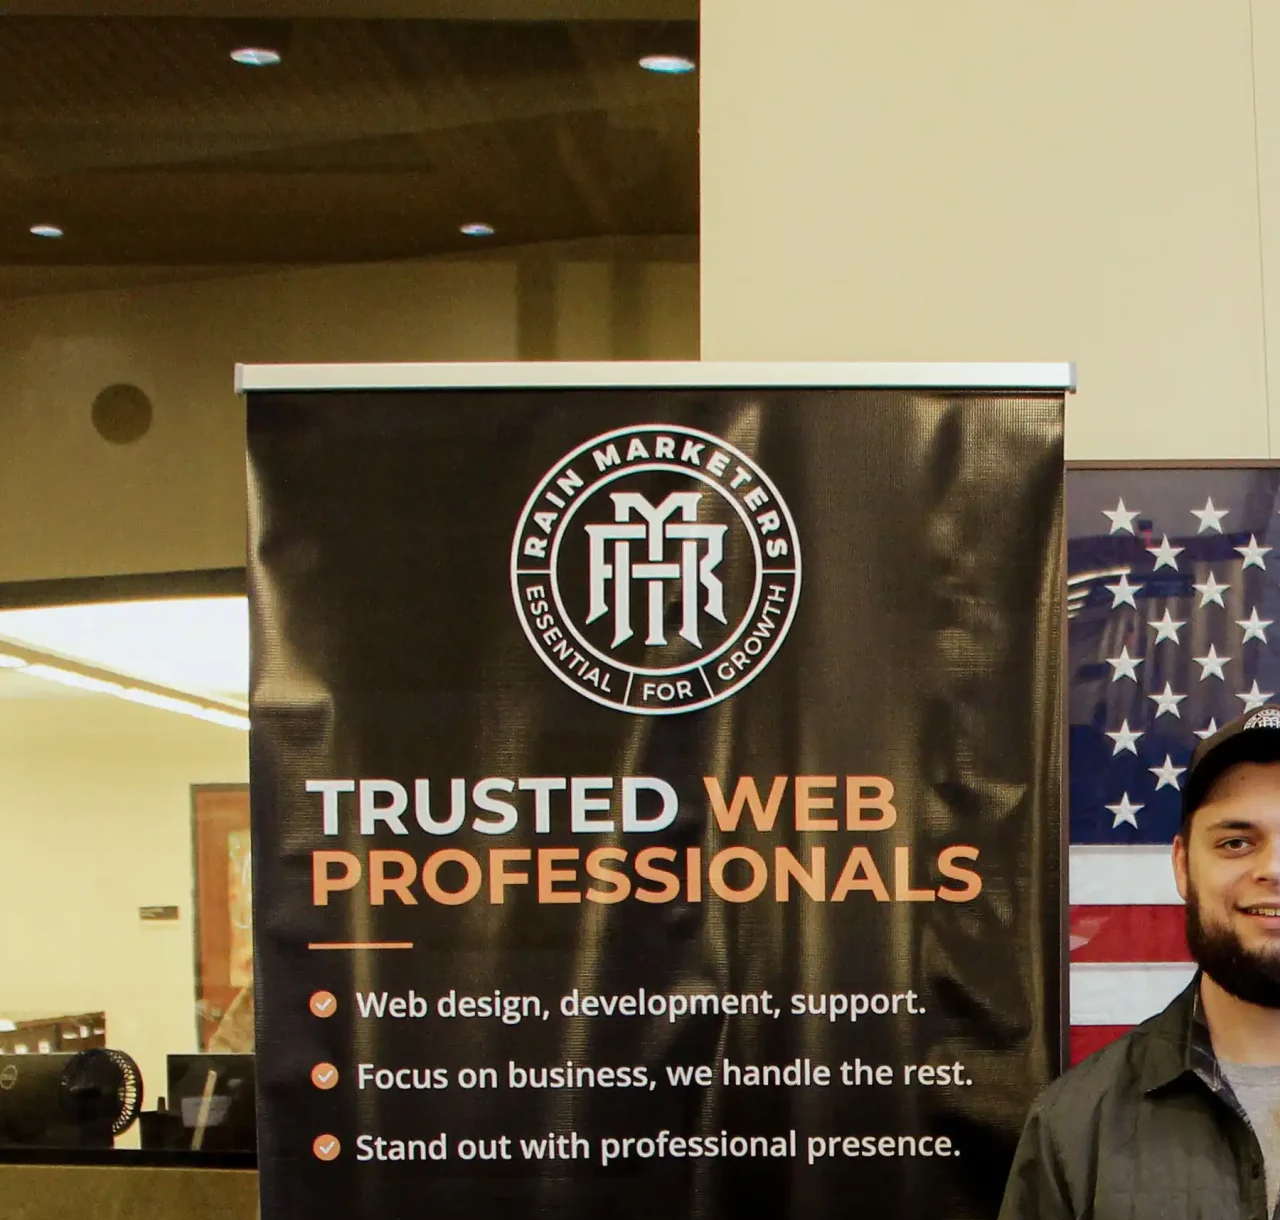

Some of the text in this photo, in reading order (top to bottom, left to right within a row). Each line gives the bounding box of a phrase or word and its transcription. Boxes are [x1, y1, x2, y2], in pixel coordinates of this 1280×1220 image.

[524, 436, 788, 559] RAIN MARKETERS
[525, 584, 787, 701] ESSENTIAL FOR GROWTH
[306, 777, 896, 833] TRUSTED WEB
[313, 847, 982, 904] PROFESSIONALS
[356, 988, 925, 1023] Web design, development, support.
[358, 1058, 972, 1089] Focus on business, we handle the rest.
[356, 1131, 960, 1164] Stand out with professional presence.
